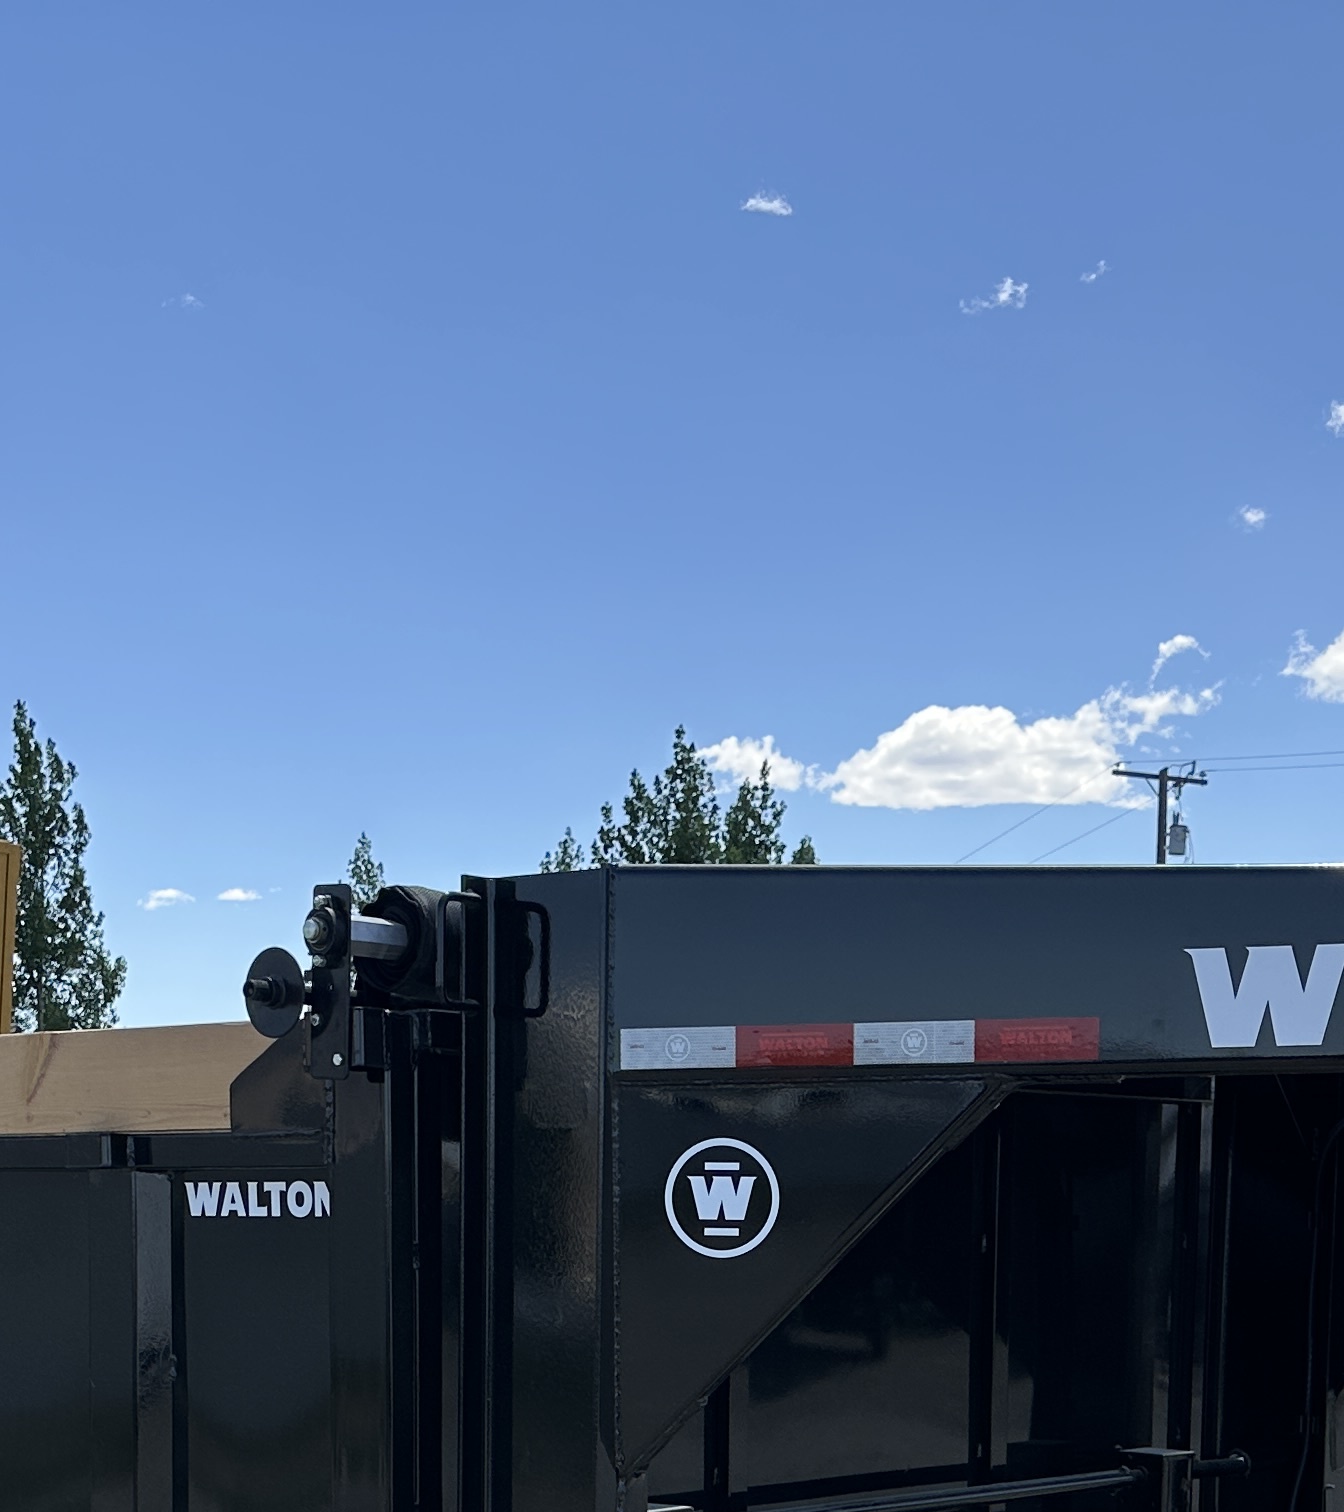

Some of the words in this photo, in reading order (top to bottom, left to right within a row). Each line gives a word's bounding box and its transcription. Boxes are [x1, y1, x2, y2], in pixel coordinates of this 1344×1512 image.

[759, 1037, 829, 1050] WALTON
[1000, 1030, 1073, 1044] WALTON
[687, 1175, 757, 1221] W
